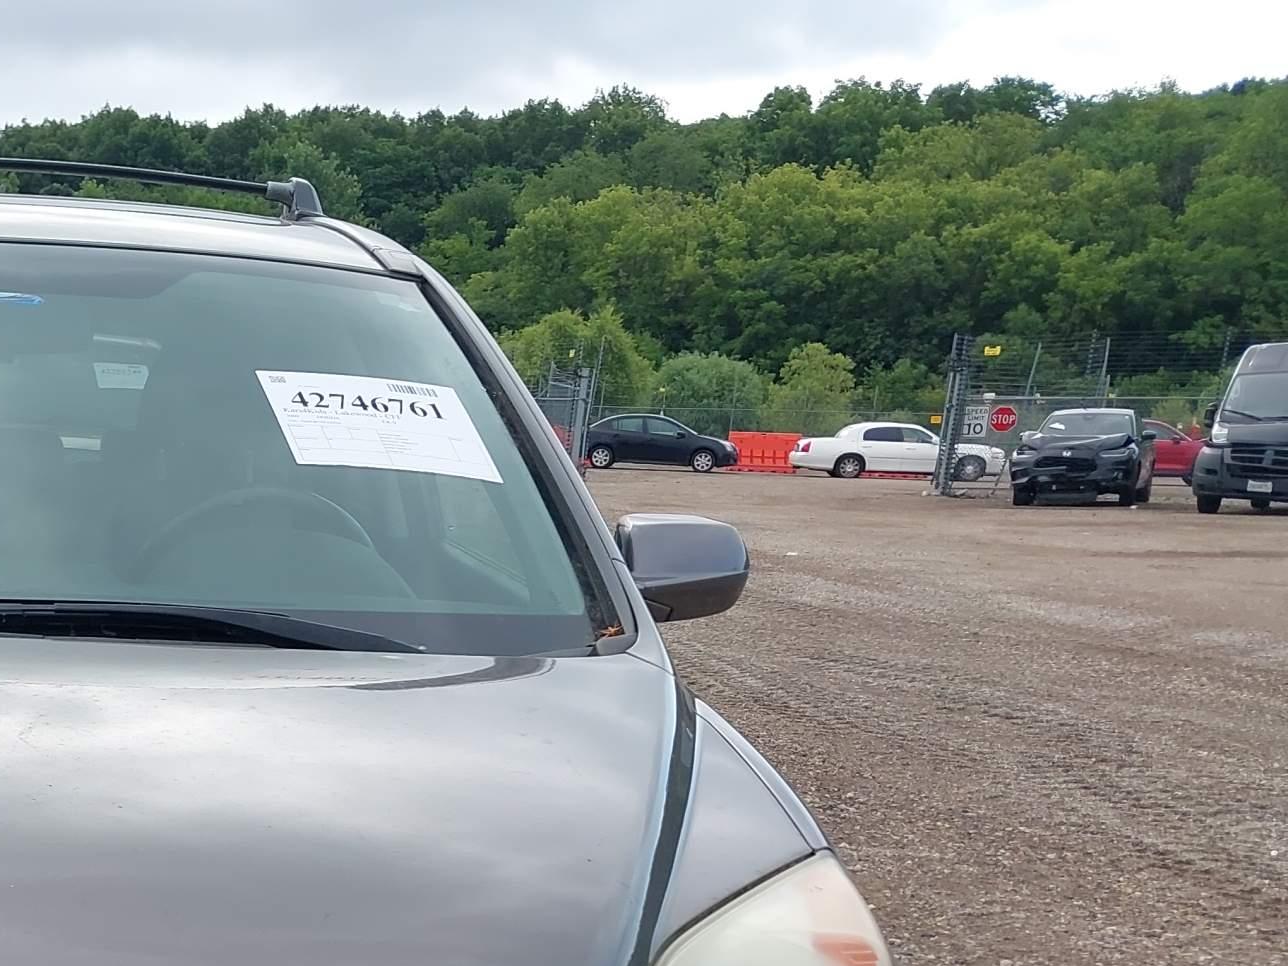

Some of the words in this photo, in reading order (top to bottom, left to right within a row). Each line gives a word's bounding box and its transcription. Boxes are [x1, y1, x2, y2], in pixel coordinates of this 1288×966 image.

[290, 391, 446, 420] 42746761
[991, 414, 1016, 425] STOP
[962, 422, 984, 435] 10
